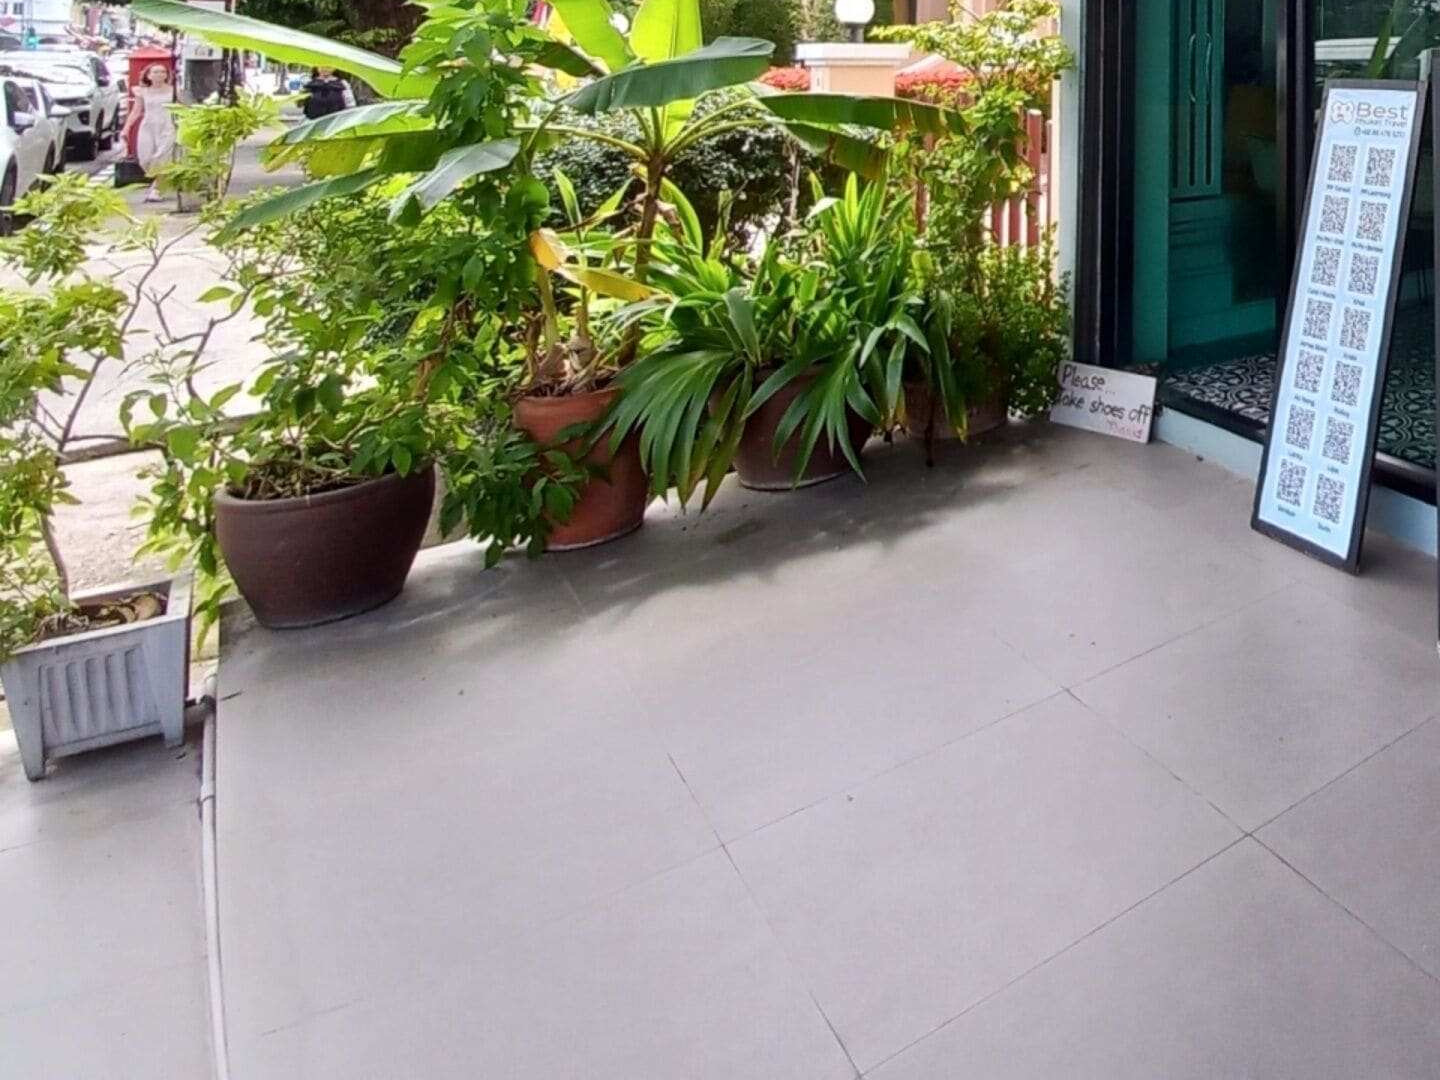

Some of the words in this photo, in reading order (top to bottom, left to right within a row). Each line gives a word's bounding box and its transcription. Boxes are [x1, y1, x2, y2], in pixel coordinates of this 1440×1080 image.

[1356, 102, 1409, 120] Best
[1063, 363, 1105, 391] Please
[1060, 392, 1085, 409] ake
[1089, 395, 1125, 419] shoes
[1128, 404, 1152, 424] off
